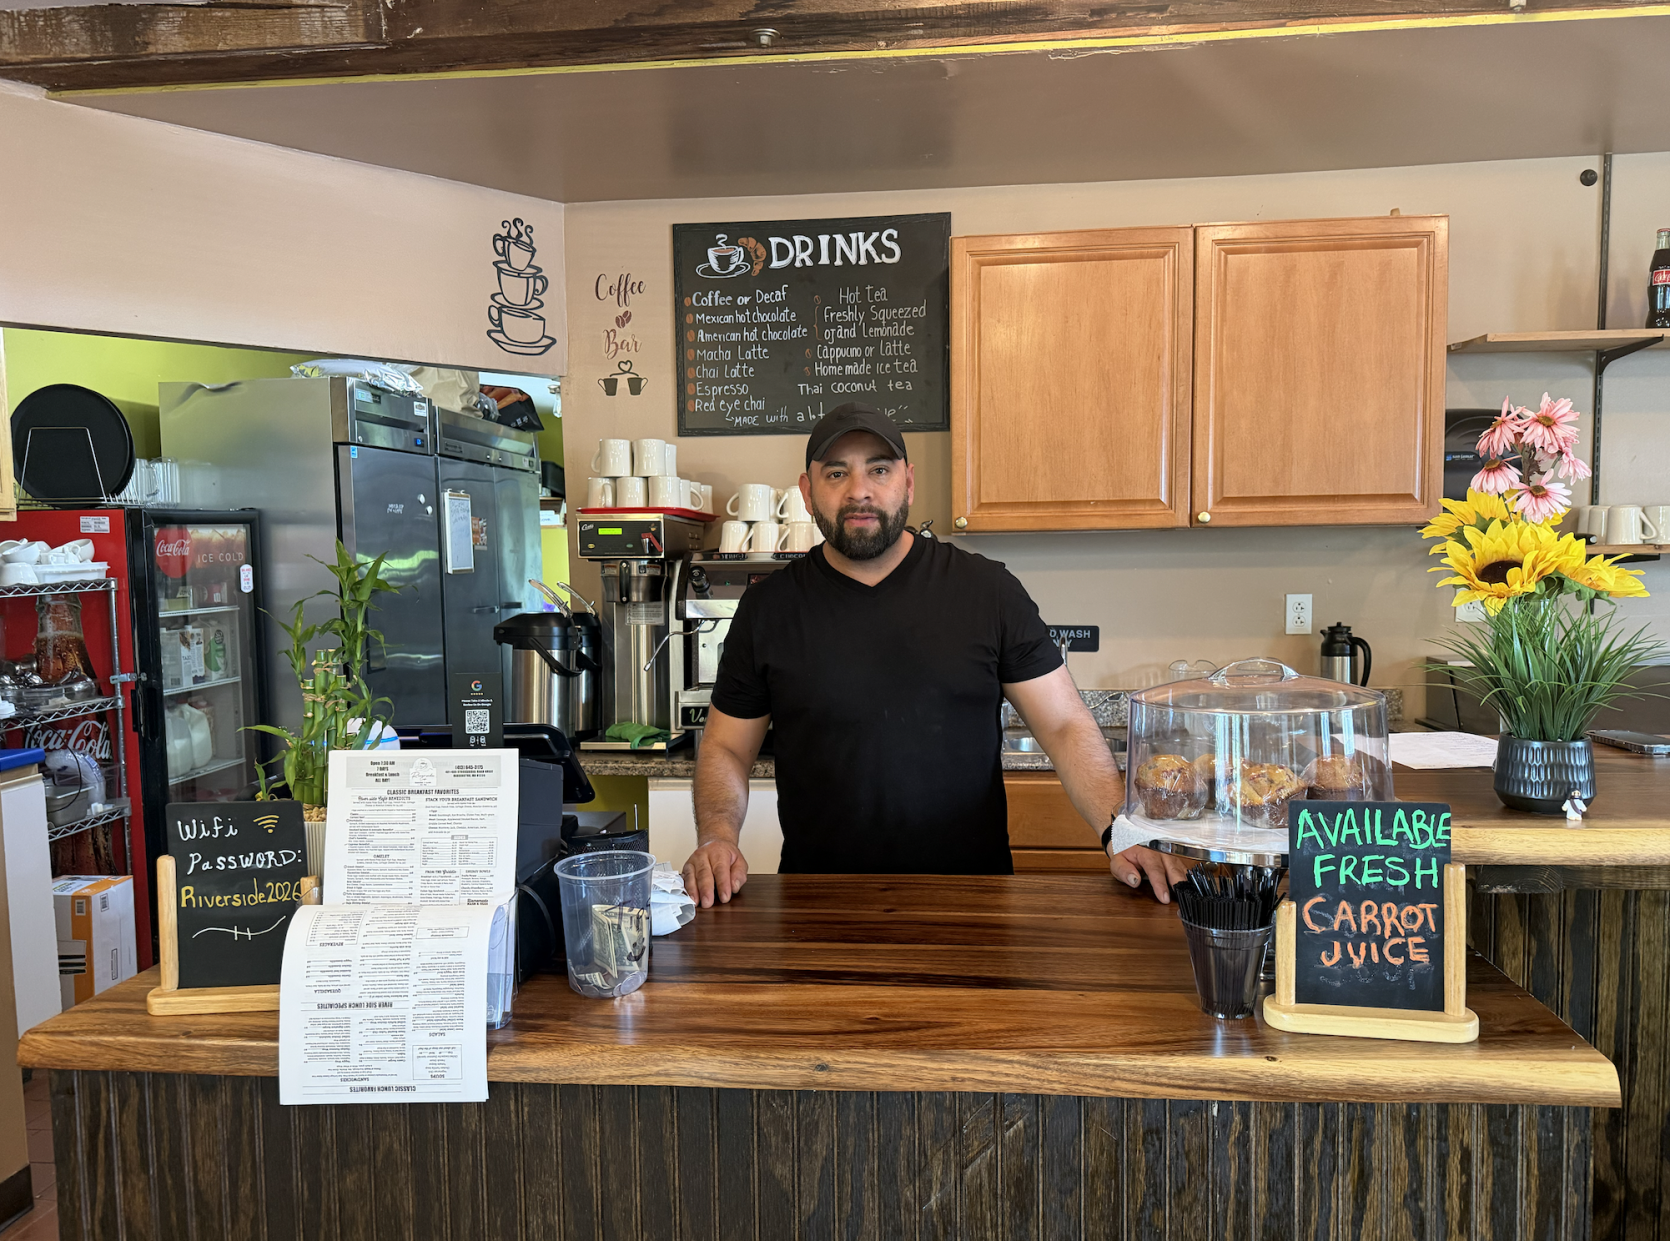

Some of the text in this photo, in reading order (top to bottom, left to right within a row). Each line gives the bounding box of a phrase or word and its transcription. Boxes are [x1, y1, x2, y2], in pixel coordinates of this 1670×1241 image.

[768, 228, 901, 269] DRINKS
[594, 272, 647, 308] Coffee
[692, 284, 789, 307] Coffee or Decaf
[839, 285, 862, 304] Hot
[695, 306, 797, 325] Mexican hot chocolate
[824, 299, 927, 326] Freshly Squeezed
[697, 323, 808, 342] American hot chocolate
[603, 328, 642, 360] Bar
[696, 343, 770, 361] Macha Latte
[864, 346, 875, 357] or
[695, 362, 755, 379] Chai Latte
[893, 358, 918, 374] tea
[696, 381, 749, 401] Espresso
[797, 379, 913, 396] Thai coconut tea
[694, 395, 766, 418] Red eye chai
[766, 405, 789, 423] with
[796, 411, 805, 422] a
[197, 552, 244, 563] ICE COLD
[1060, 630, 1091, 639] WASH
[177, 816, 238, 841] Wifi
[1296, 807, 1452, 849] AVAILABLE
[1313, 854, 1439, 890] FRESH
[181, 877, 302, 908] Riverside2026
[1302, 896, 1439, 939] CARROT
[1320, 936, 1430, 969] JUICE
[317, 1002, 347, 1010] SPECIALTIES
